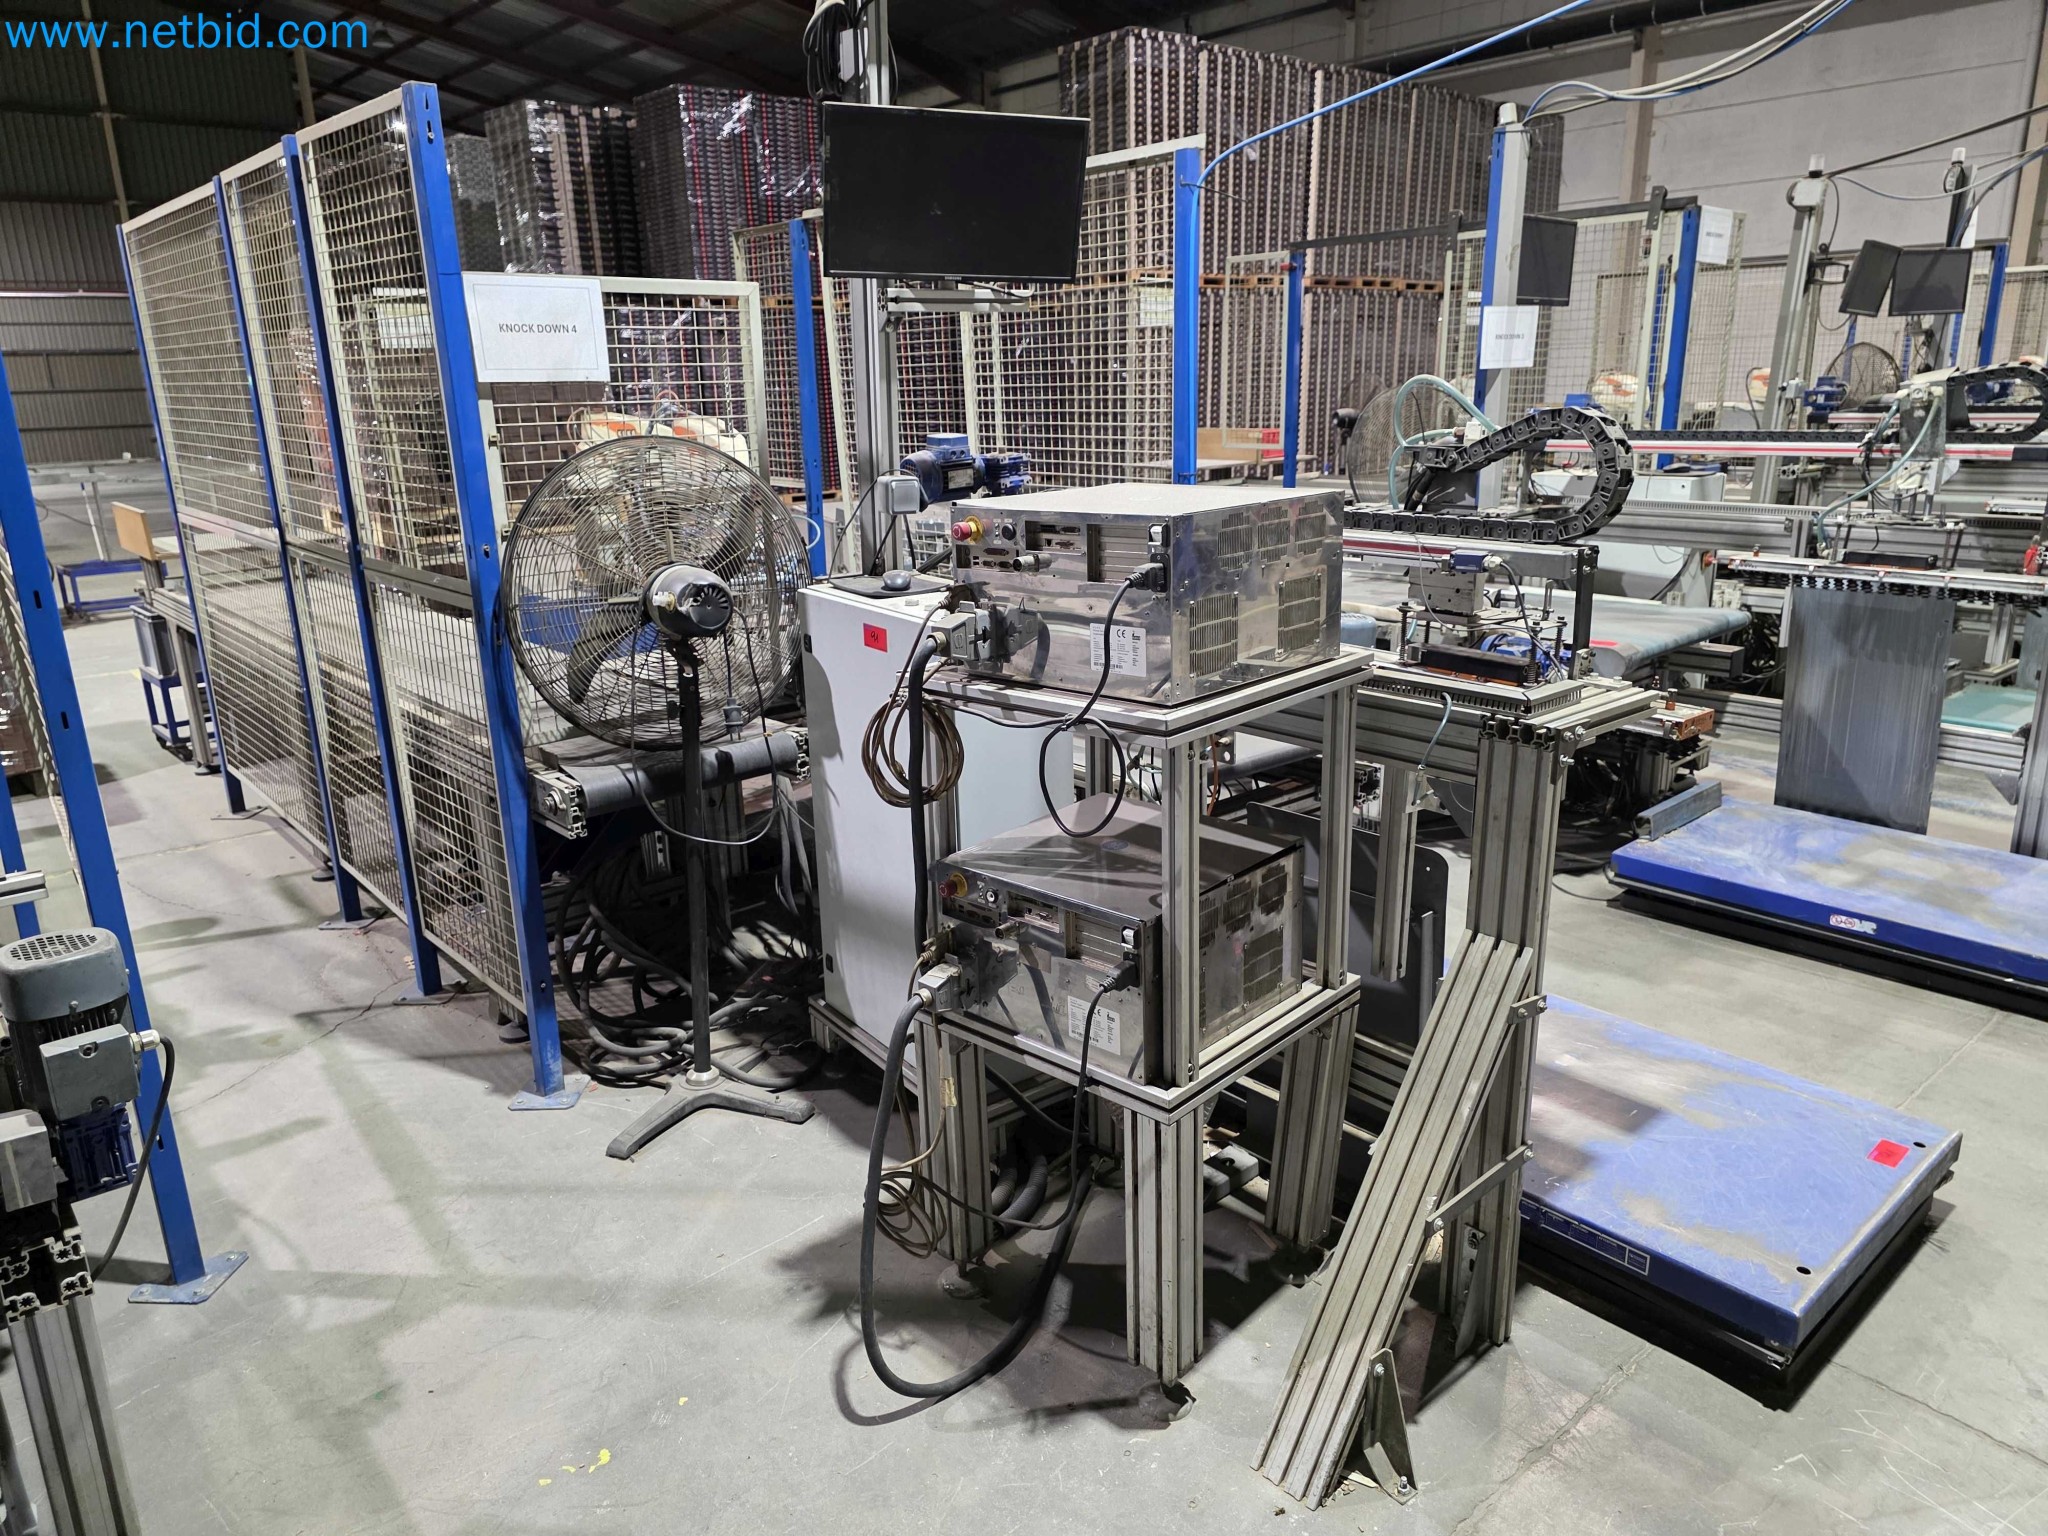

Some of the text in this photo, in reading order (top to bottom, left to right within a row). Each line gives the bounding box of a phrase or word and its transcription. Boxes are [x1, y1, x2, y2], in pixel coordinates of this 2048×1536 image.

[498, 323, 578, 334] KNOCK DOWN 4
